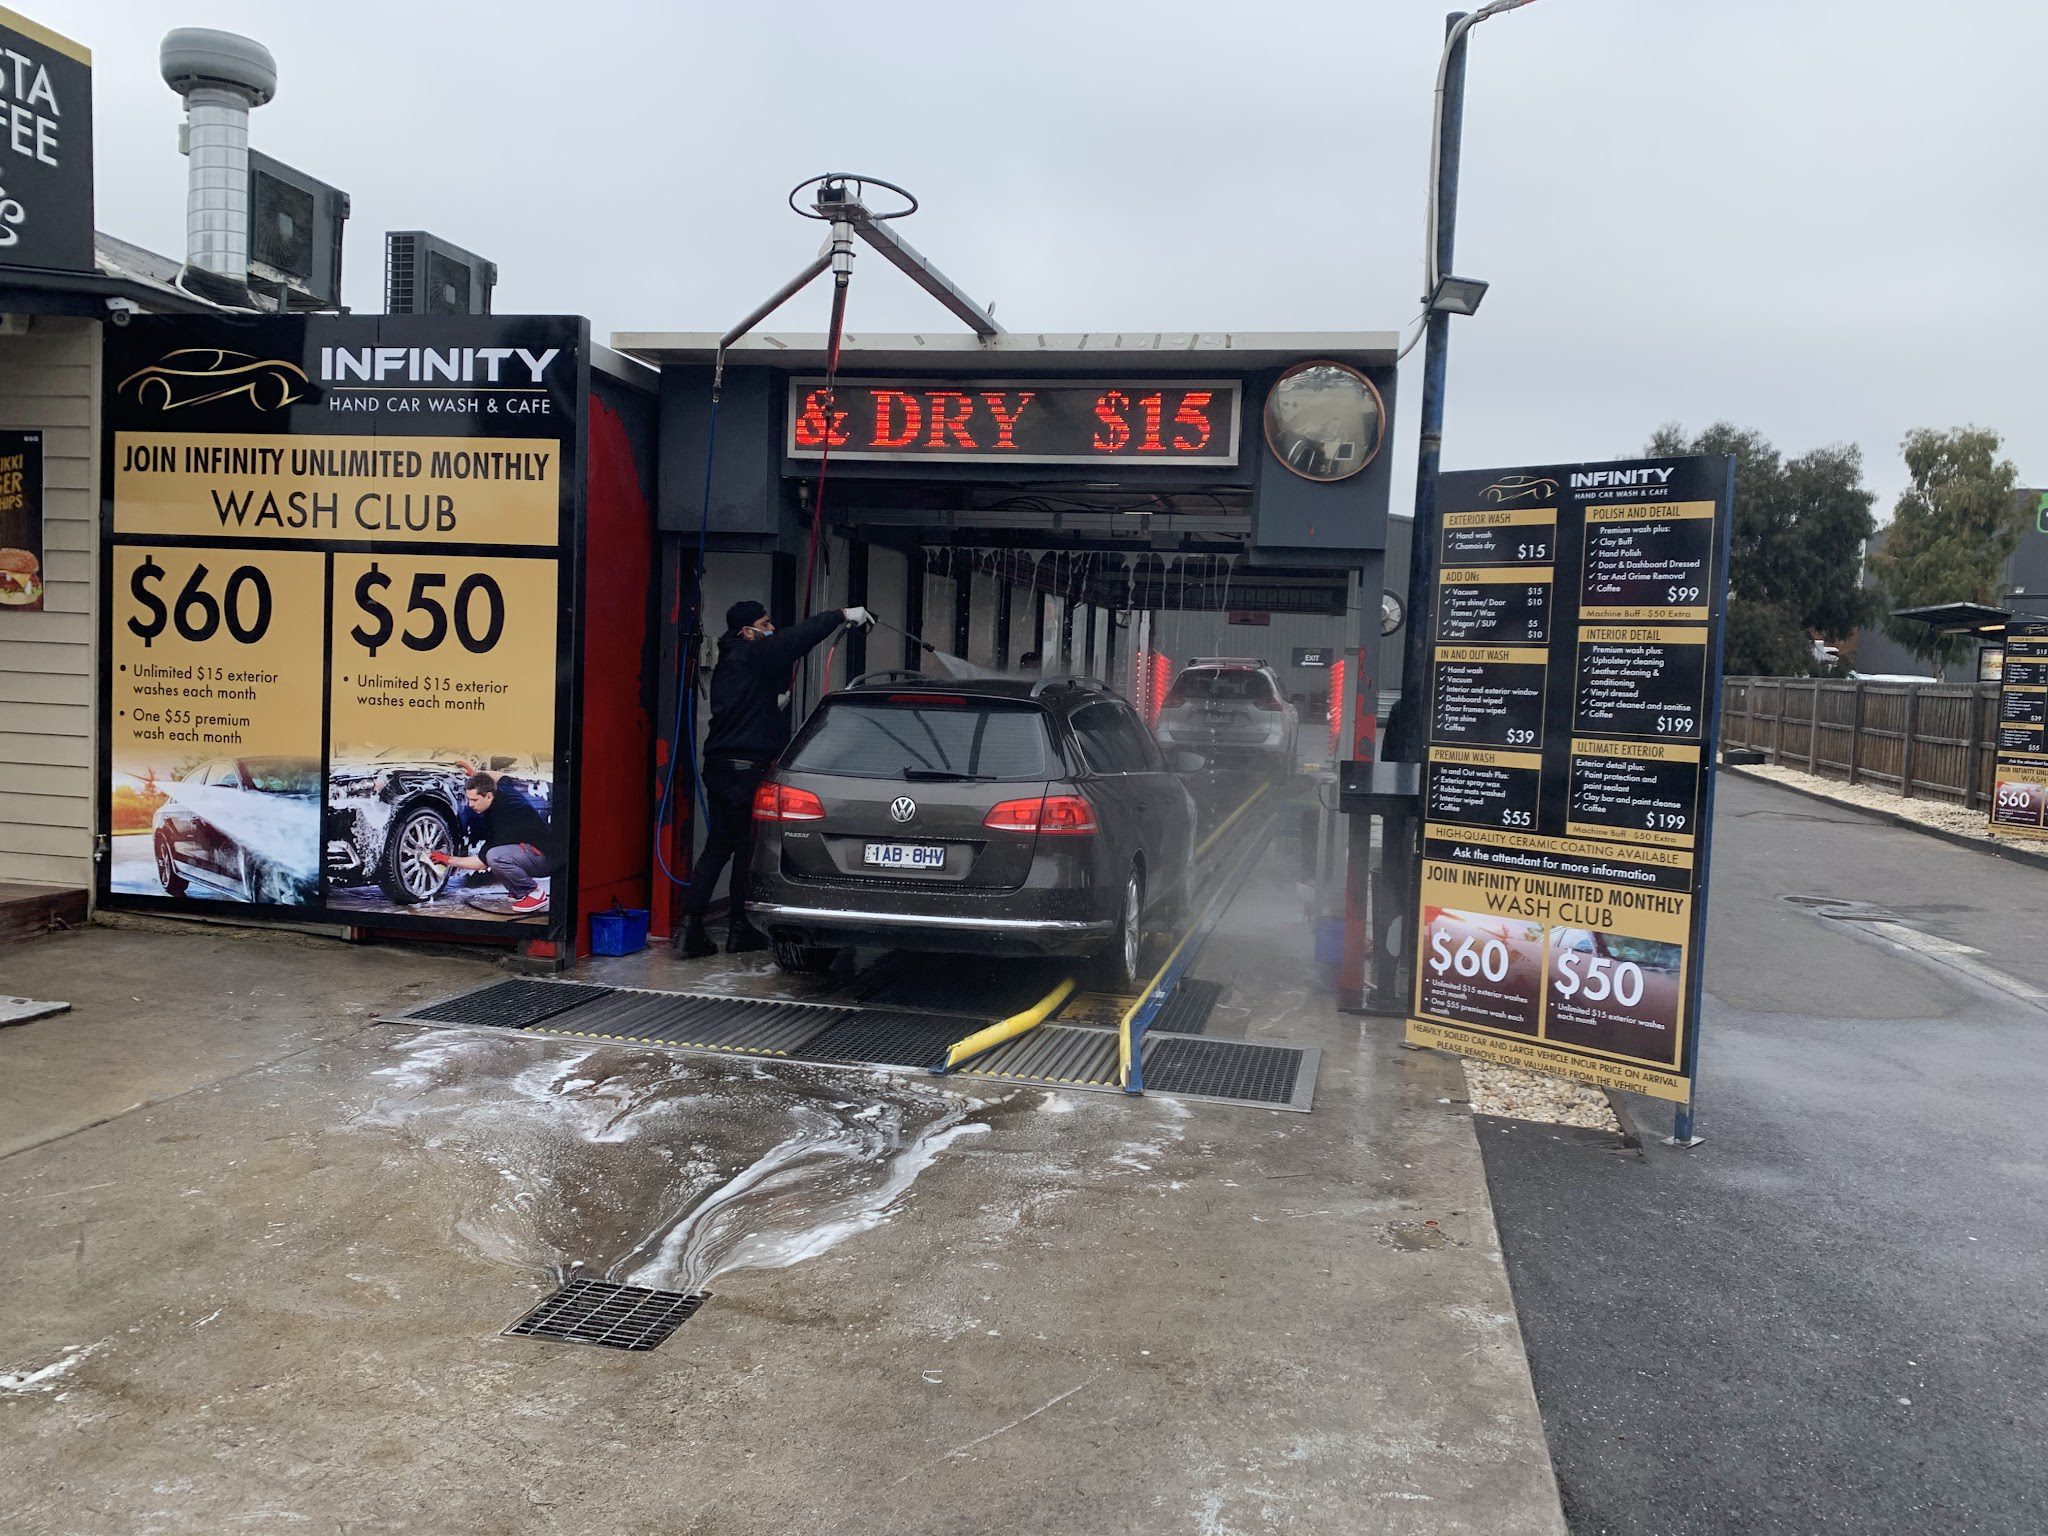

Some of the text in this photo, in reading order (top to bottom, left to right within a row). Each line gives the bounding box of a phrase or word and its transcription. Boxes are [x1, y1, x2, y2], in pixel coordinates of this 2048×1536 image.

[0, 48, 60, 116] TA
[321, 347, 560, 382] INFINITY
[329, 396, 550, 414] HAND CAR WASH & CAFE
[796, 390, 1214, 452] & DRY $15
[123, 445, 549, 480] JOIN INFINITY UNLIMITED MONTHLY
[1570, 467, 1674, 487] INFINITY
[210, 489, 456, 531] WASH CLUB
[1593, 505, 1680, 519] POLISH AND DETAIL
[1449, 513, 1510, 525] EXTERIOR WASH
[1455, 530, 1492, 539] Hand wash
[1599, 524, 1670, 534] Premium wash plus:
[1483, 541, 1496, 550] dry
[1599, 536, 1633, 547] Clay Buff
[1517, 543, 1545, 559] $15
[1598, 548, 1641, 557] Hand Polish
[1598, 558, 1700, 569] Door & Dashboard Dressed
[1445, 571, 1479, 581] ADD ONs
[1596, 571, 1685, 580] Tar And Grime Removal
[1527, 586, 1542, 595] $15
[1596, 583, 1621, 592] Coffee
[1667, 585, 1699, 603] $99
[127, 554, 272, 647] $60
[1527, 597, 1542, 606] $10
[350, 562, 504, 657] $50
[1586, 609, 1622, 617] Machine
[1624, 609, 1641, 617] Buff
[1646, 608, 1666, 619] $50
[1668, 609, 1690, 617] Extra
[1528, 619, 1537, 627] $5
[1527, 630, 1542, 638] $10
[1586, 628, 1661, 640] INTERIOR DETAIL
[1304, 654, 1320, 662] EXIT
[1440, 649, 1509, 660] IN AND OUT WASH
[133, 663, 278, 683] Unlimited $15 exterior
[133, 681, 255, 700] washes each month
[357, 673, 508, 693] Unlimited $15 exterior
[356, 691, 484, 710] washes each month
[132, 708, 249, 728] One $55 premium
[1656, 715, 1693, 732] $199
[132, 725, 241, 744] wash each month
[1506, 727, 1534, 743] $39
[1434, 749, 1494, 763] PREMIUM WASH
[1577, 741, 1664, 757] ULTIMATE EXTERIOR
[1576, 758, 1645, 772] Exterior detail plus:
[2021, 774, 2047, 784] WASH
[1998, 789, 2031, 808] $60
[1502, 808, 1530, 825] $55
[1436, 827, 1678, 864] HIGH-QUALITY CERAMIC COATING AVAILABLE
[1452, 846, 1655, 881] Ask the attendant for more information
[1426, 865, 1683, 914] JOIN INFINITY UNLIMITED MONTHLY
[1485, 891, 1613, 927] WASH CLUB
[1428, 927, 1510, 982] $60
[1553, 948, 1644, 1007] $50
[1413, 1023, 1678, 1087] HEAVILY SOILED CAR AND LARGE VEHICLE INCUR PRICE ON ARRIVAL
[1436, 1040, 1649, 1095] PLEASE REMOVE YOUR VALUABLES FROM THE VEHICLE
